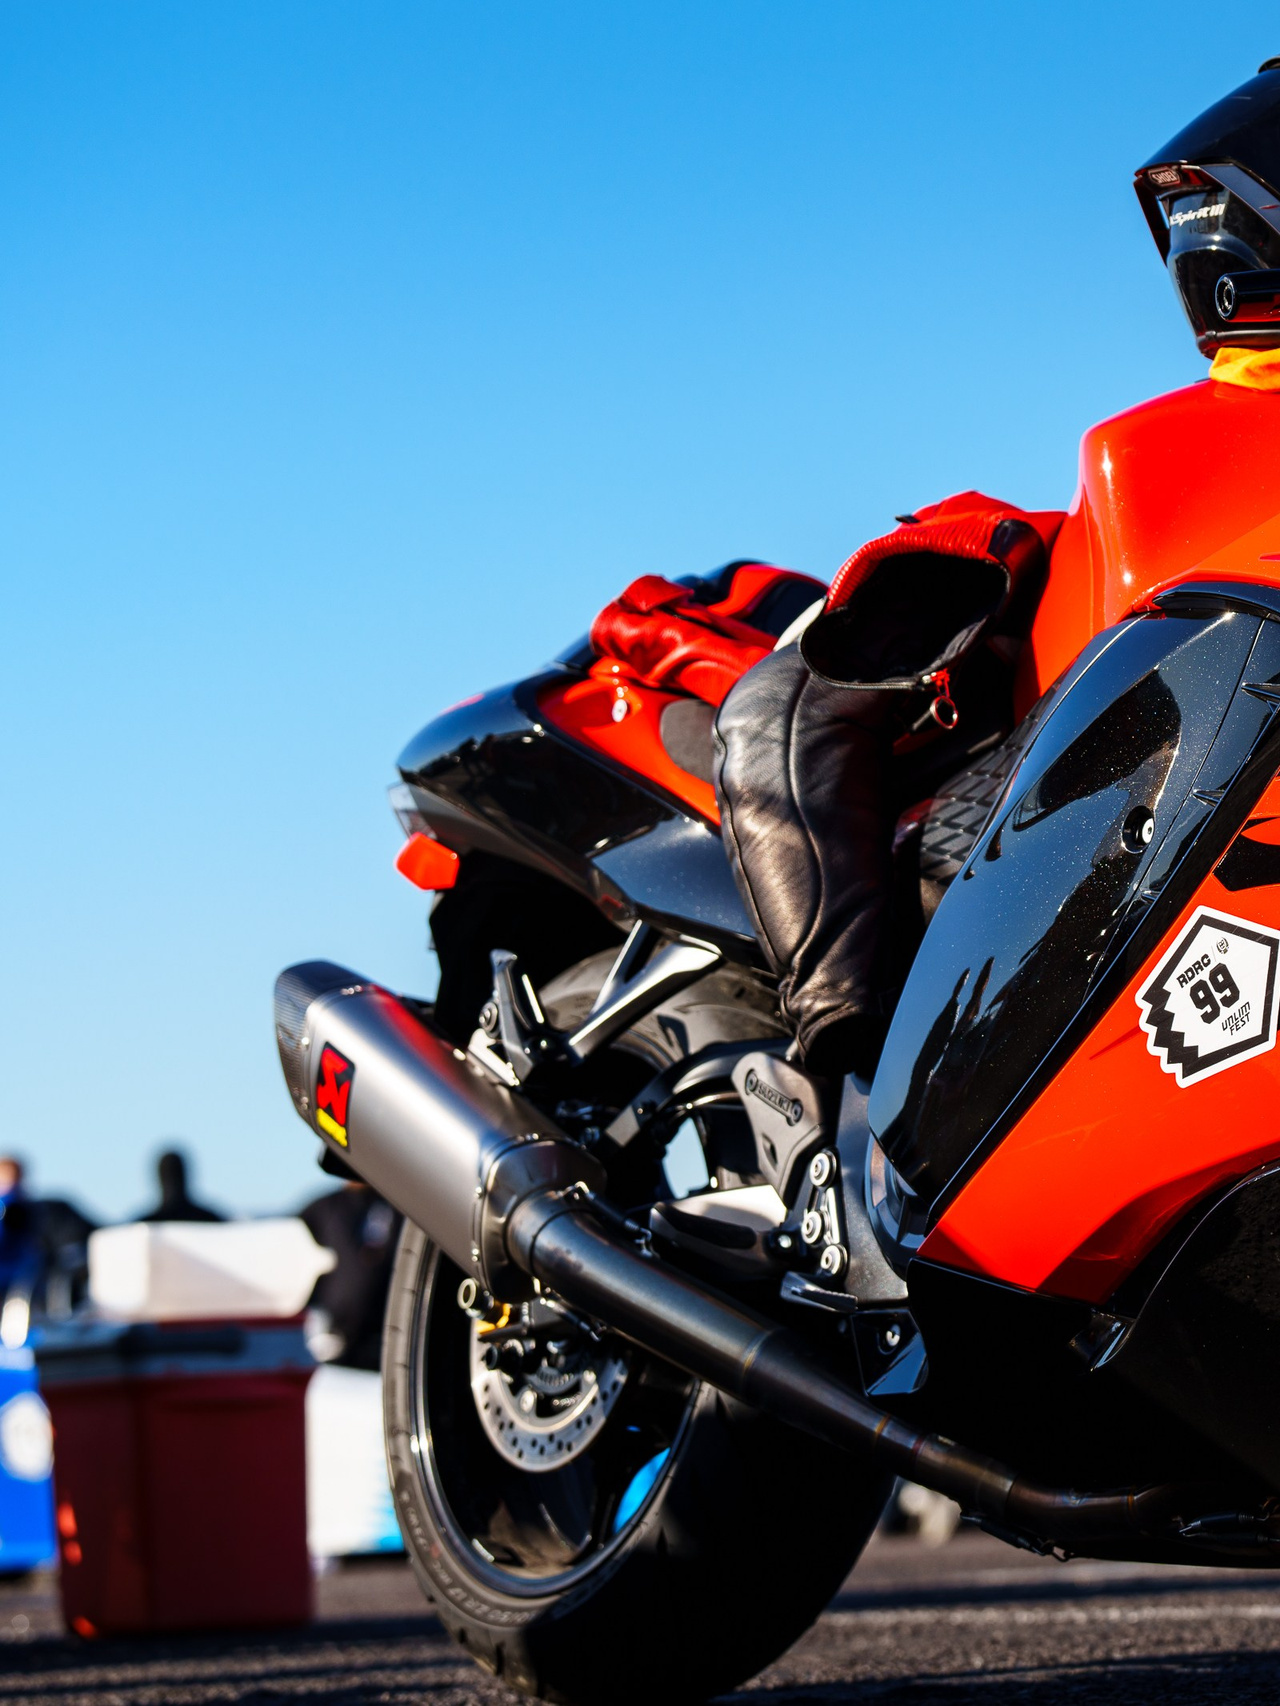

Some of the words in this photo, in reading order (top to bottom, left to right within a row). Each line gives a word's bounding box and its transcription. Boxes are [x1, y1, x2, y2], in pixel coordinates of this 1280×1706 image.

[1151, 171, 1178, 184] SHOEI
[1189, 962, 1240, 1025] 99
[1229, 1012, 1251, 1036] FEST
[758, 1083, 792, 1112] SUZUKI
